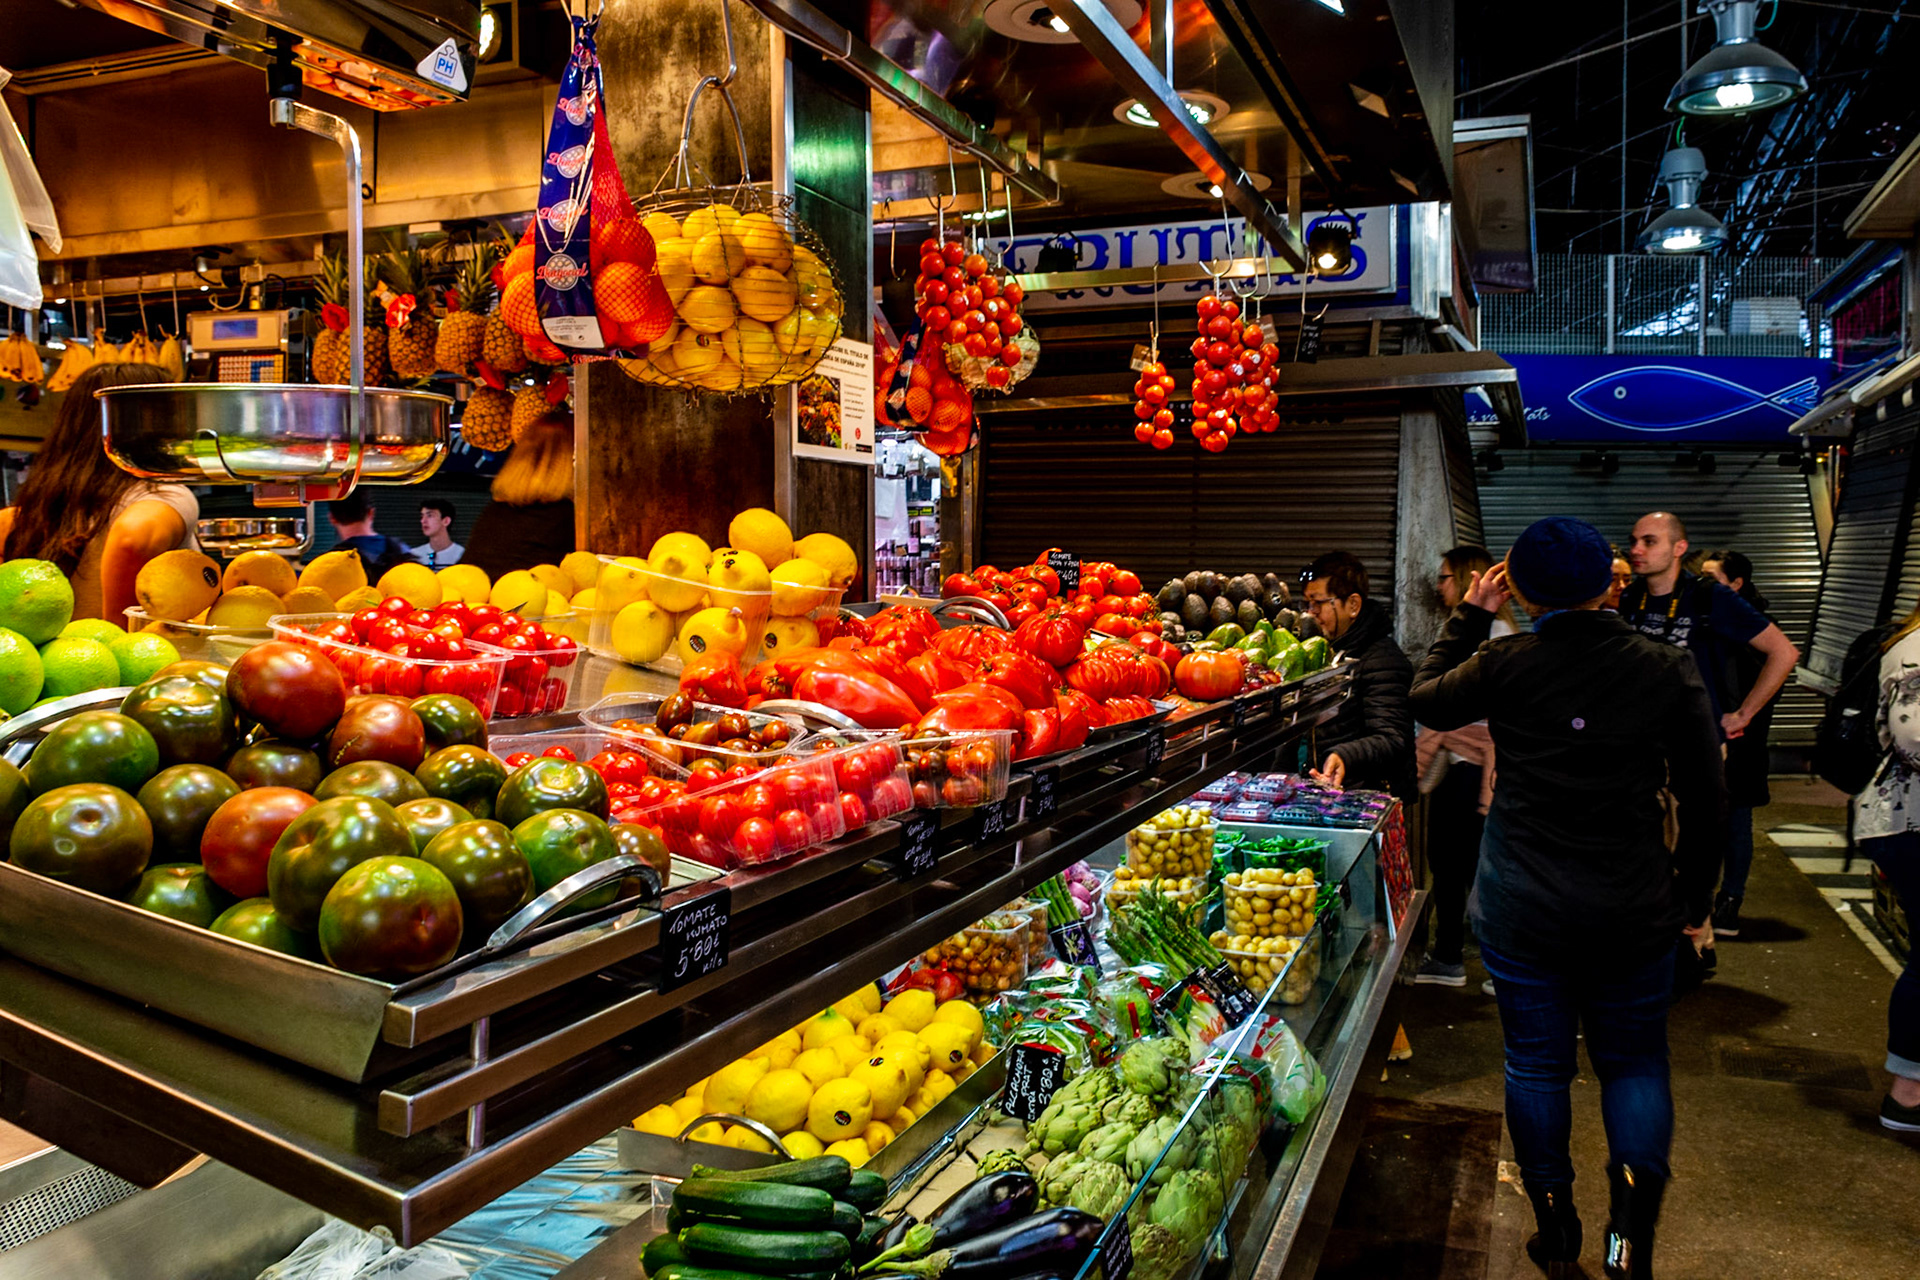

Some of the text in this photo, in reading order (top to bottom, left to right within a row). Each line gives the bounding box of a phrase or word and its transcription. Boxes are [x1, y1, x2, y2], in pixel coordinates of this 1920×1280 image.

[437, 57, 455, 75] PH
[669, 903, 716, 935] TOMATE
[686, 914, 728, 942] KUMATO
[1005, 1049, 1026, 1115] ALCACHOFA
[1021, 1064, 1033, 1098] PRAT
